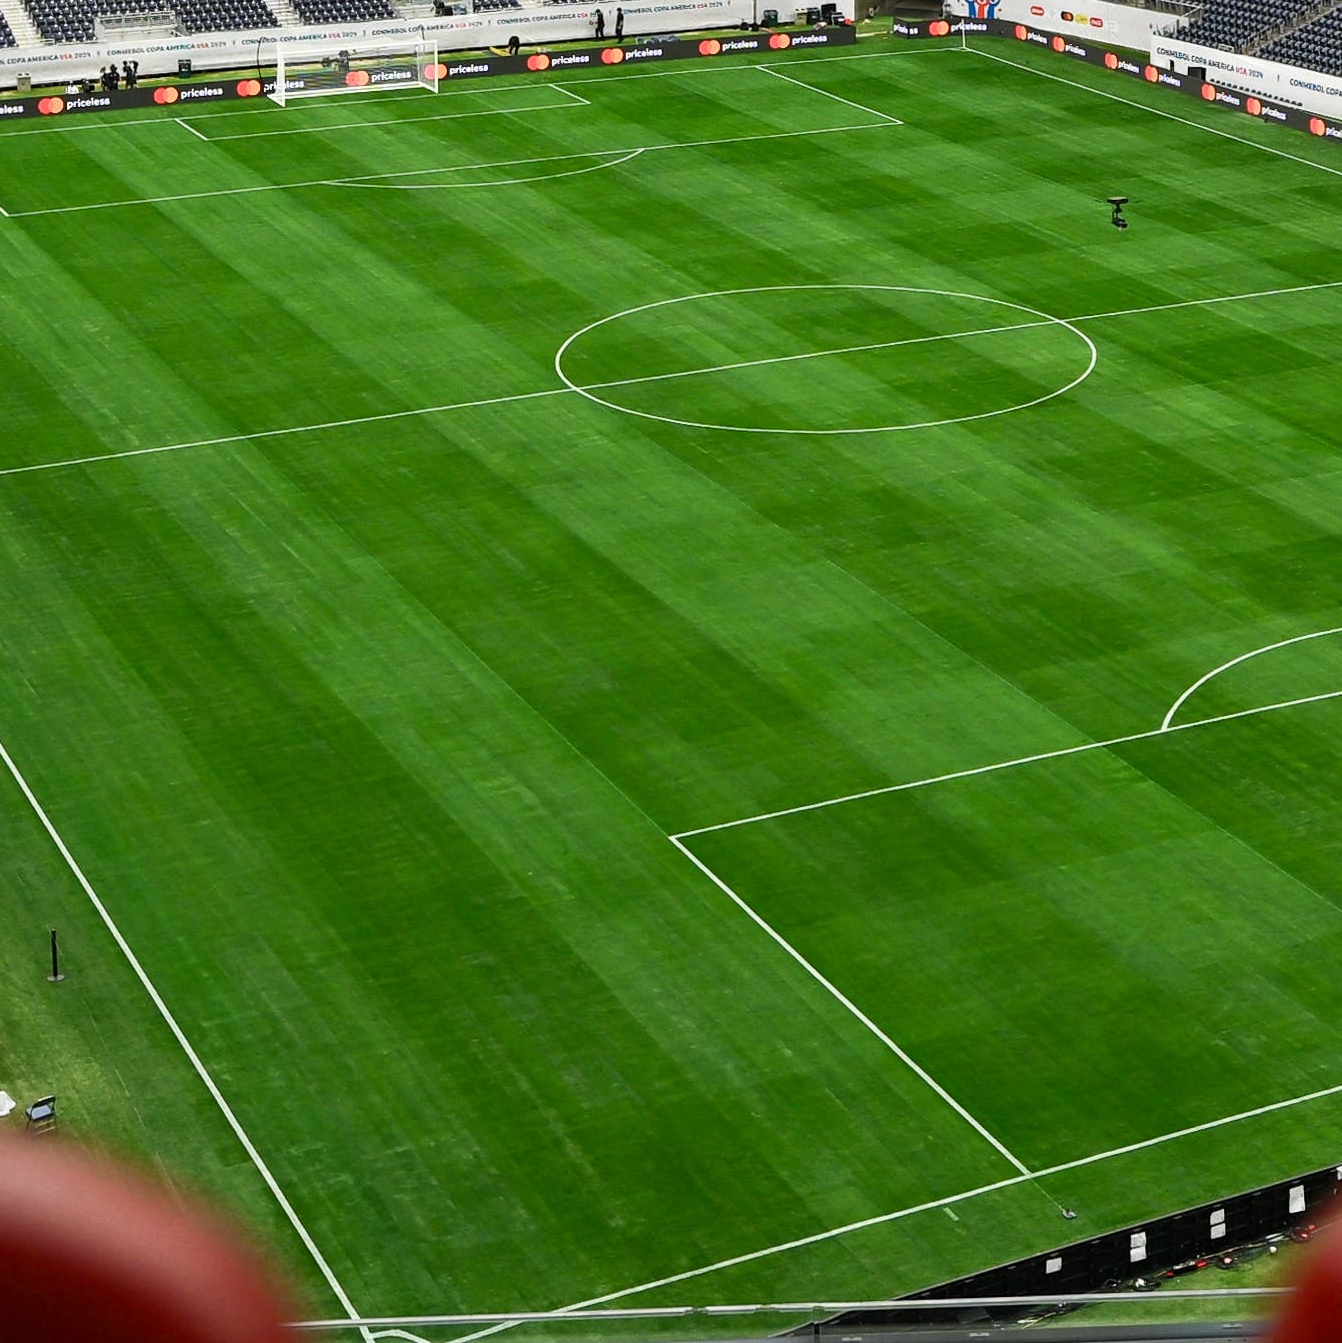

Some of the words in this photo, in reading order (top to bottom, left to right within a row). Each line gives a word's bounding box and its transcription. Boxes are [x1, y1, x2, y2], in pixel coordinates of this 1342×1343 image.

[625, 47, 663, 60] priceless
[551, 54, 590, 67] priceless
[448, 63, 489, 76] priceless
[180, 87, 223, 100] priceless
[66, 97, 111, 110] priceless
